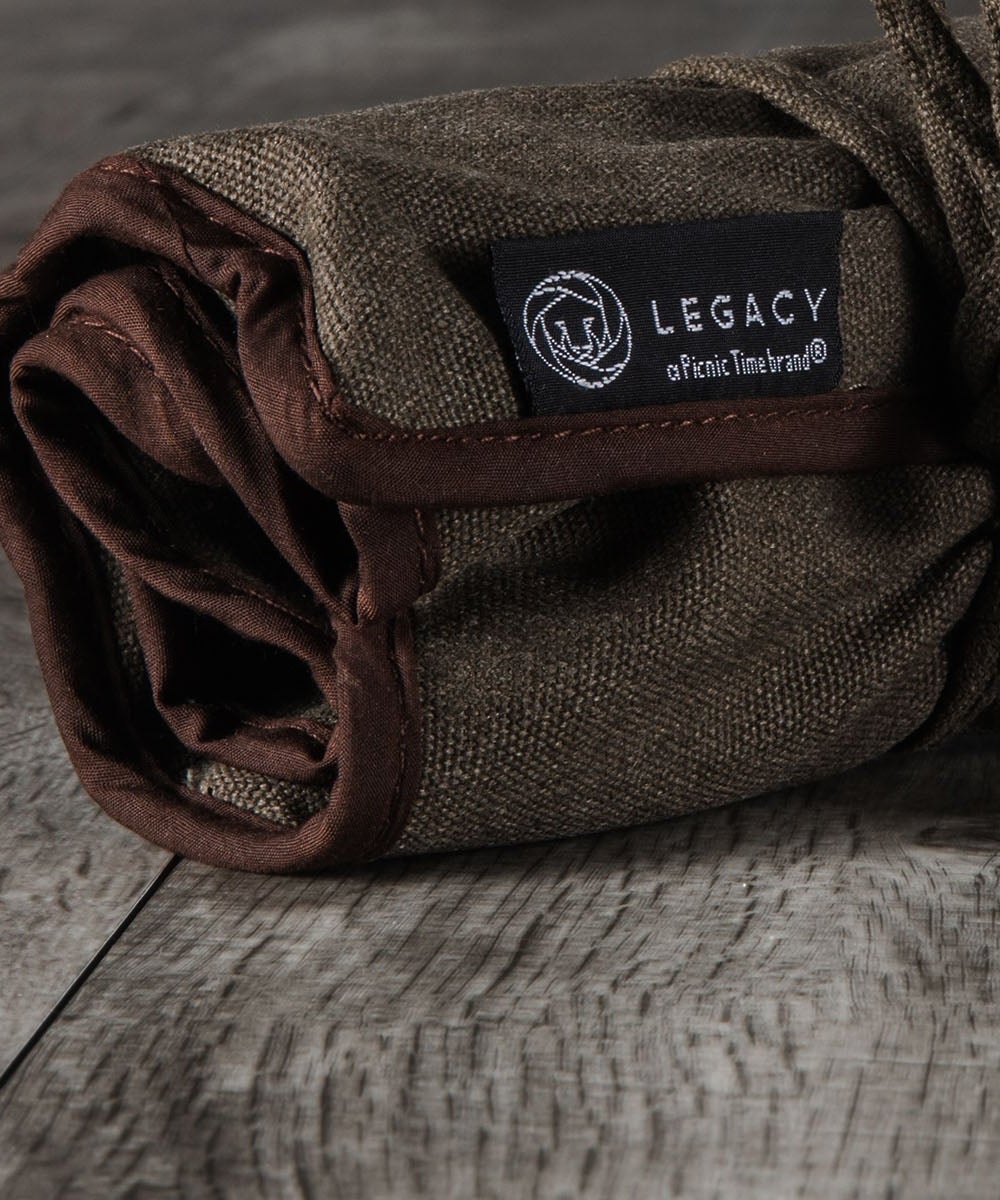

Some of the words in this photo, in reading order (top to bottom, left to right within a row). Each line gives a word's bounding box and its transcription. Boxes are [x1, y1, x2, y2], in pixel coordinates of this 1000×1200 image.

[651, 288, 827, 335] LEGACY
[680, 353, 730, 379] Picnic
[729, 349, 767, 375] Time
